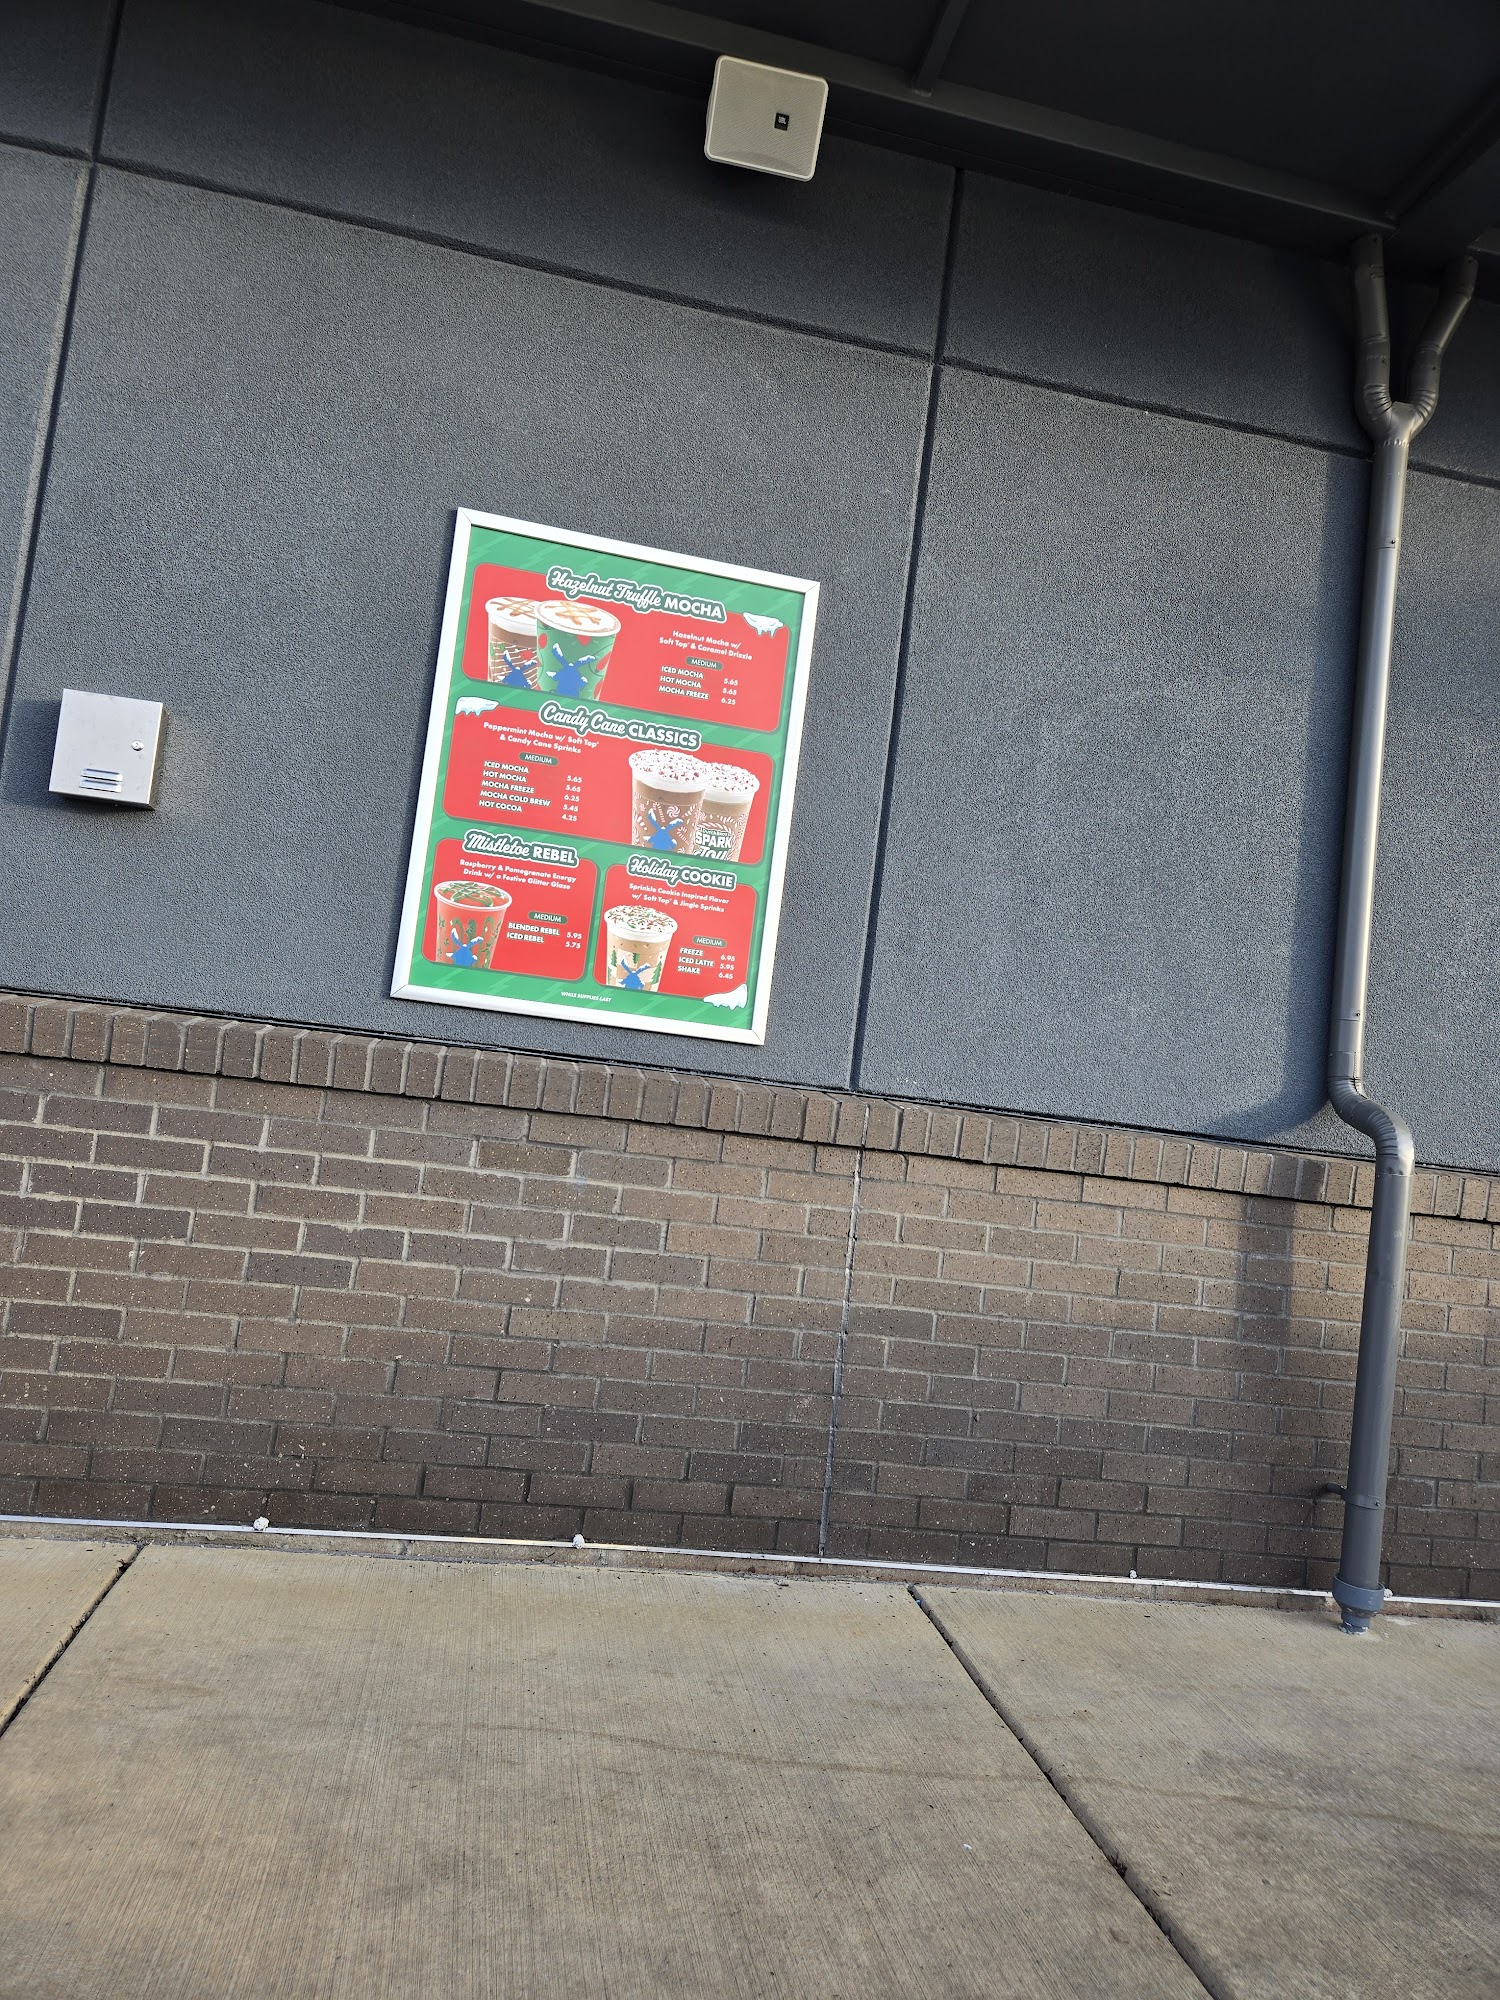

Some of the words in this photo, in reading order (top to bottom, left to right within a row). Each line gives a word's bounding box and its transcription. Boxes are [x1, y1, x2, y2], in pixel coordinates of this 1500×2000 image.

[552, 570, 612, 596] Hazelnut
[614, 583, 662, 610] Truffle
[664, 596, 722, 618] MOCHA
[672, 630, 704, 642] Hazelnut
[706, 636, 730, 647] Mocha
[659, 637, 674, 645] Soft
[698, 644, 727, 655] Caramel
[728, 650, 752, 660] Drizzle
[691, 659, 717, 668] MEDIUM
[661, 666, 677, 674] ICED
[678, 669, 704, 679] MOCHA
[675, 678, 702, 688] MOCHA
[659, 685, 685, 696] MOCHA
[686, 689, 709, 699] FREEZE
[483, 722, 527, 735] Peppermint
[528, 729, 553, 739] Mocha
[568, 736, 583, 744] Soft
[544, 705, 590, 731] Candy
[590, 714, 626, 734] Cane
[628, 724, 697, 747] CLASSICS
[508, 735, 531, 746] Candy
[533, 739, 552, 749] Cane
[554, 743, 581, 753] Sprinks
[524, 754, 552, 764] MEDIUM
[501, 763, 529, 774] MOCHA
[499, 772, 527, 783] MOCHA
[482, 780, 509, 790] MOCHA
[510, 784, 535, 794] FREEZE
[480, 790, 508, 800] MOCHA
[509, 795, 528, 803] COLD
[530, 798, 551, 806] BREW
[496, 802, 522, 812] COCOA
[696, 830, 732, 848] SPARK
[467, 833, 530, 856] Mistletoe
[532, 846, 575, 863] REBEL
[460, 859, 496, 871] Raspberry
[505, 866, 551, 878] Pomegranate
[552, 873, 577, 883] Energy
[631, 859, 678, 883] Holiday
[681, 870, 733, 887] COOKIE
[503, 874, 526, 882] Festive
[528, 878, 549, 886] Glitter
[551, 881, 570, 890] Glaze
[629, 883, 656, 892] Sprinkle
[658, 888, 680, 896] Cookie
[682, 892, 708, 901] Inspired
[709, 896, 729, 904] Flavor
[680, 901, 699, 909] Jingle
[701, 904, 724, 912] Sprinks
[534, 913, 562, 922] MEDIUM
[508, 923, 539, 932] BLENDED
[540, 926, 560, 935] REBEL
[524, 935, 544, 943] REBEL
[697, 937, 722, 946] MEDIUM
[680, 948, 704, 956] FREEZE
